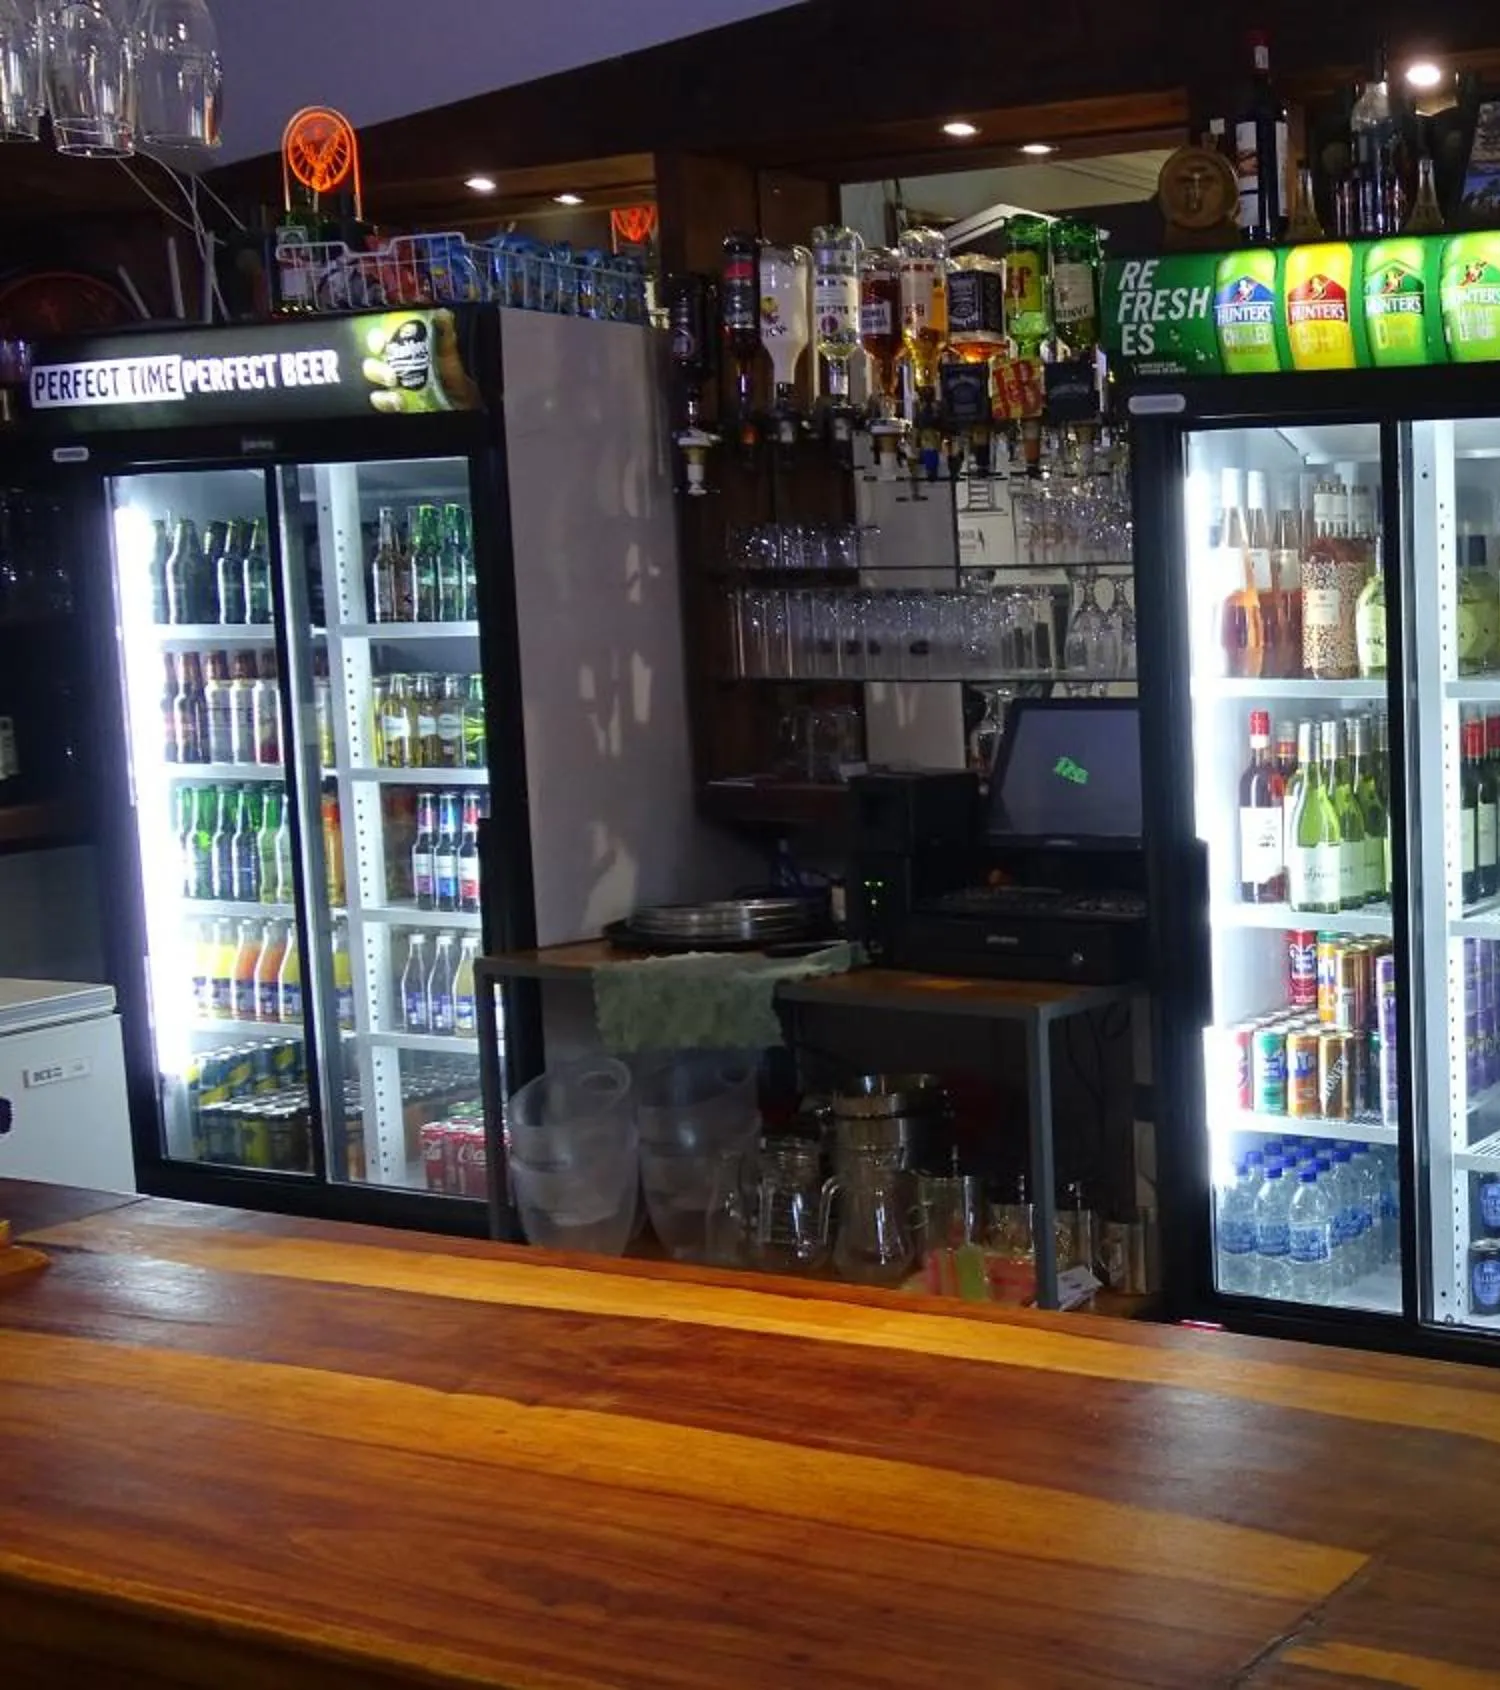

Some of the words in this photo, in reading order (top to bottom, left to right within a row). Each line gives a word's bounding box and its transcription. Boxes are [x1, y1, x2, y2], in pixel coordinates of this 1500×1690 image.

[1118, 260, 1159, 291] RE
[1117, 287, 1212, 323] FRESH
[1120, 324, 1156, 356] ES
[33, 368, 120, 402] PERFECT
[127, 361, 178, 398] TIME
[182, 354, 279, 393] PERFECT
[280, 350, 339, 387] BEER
